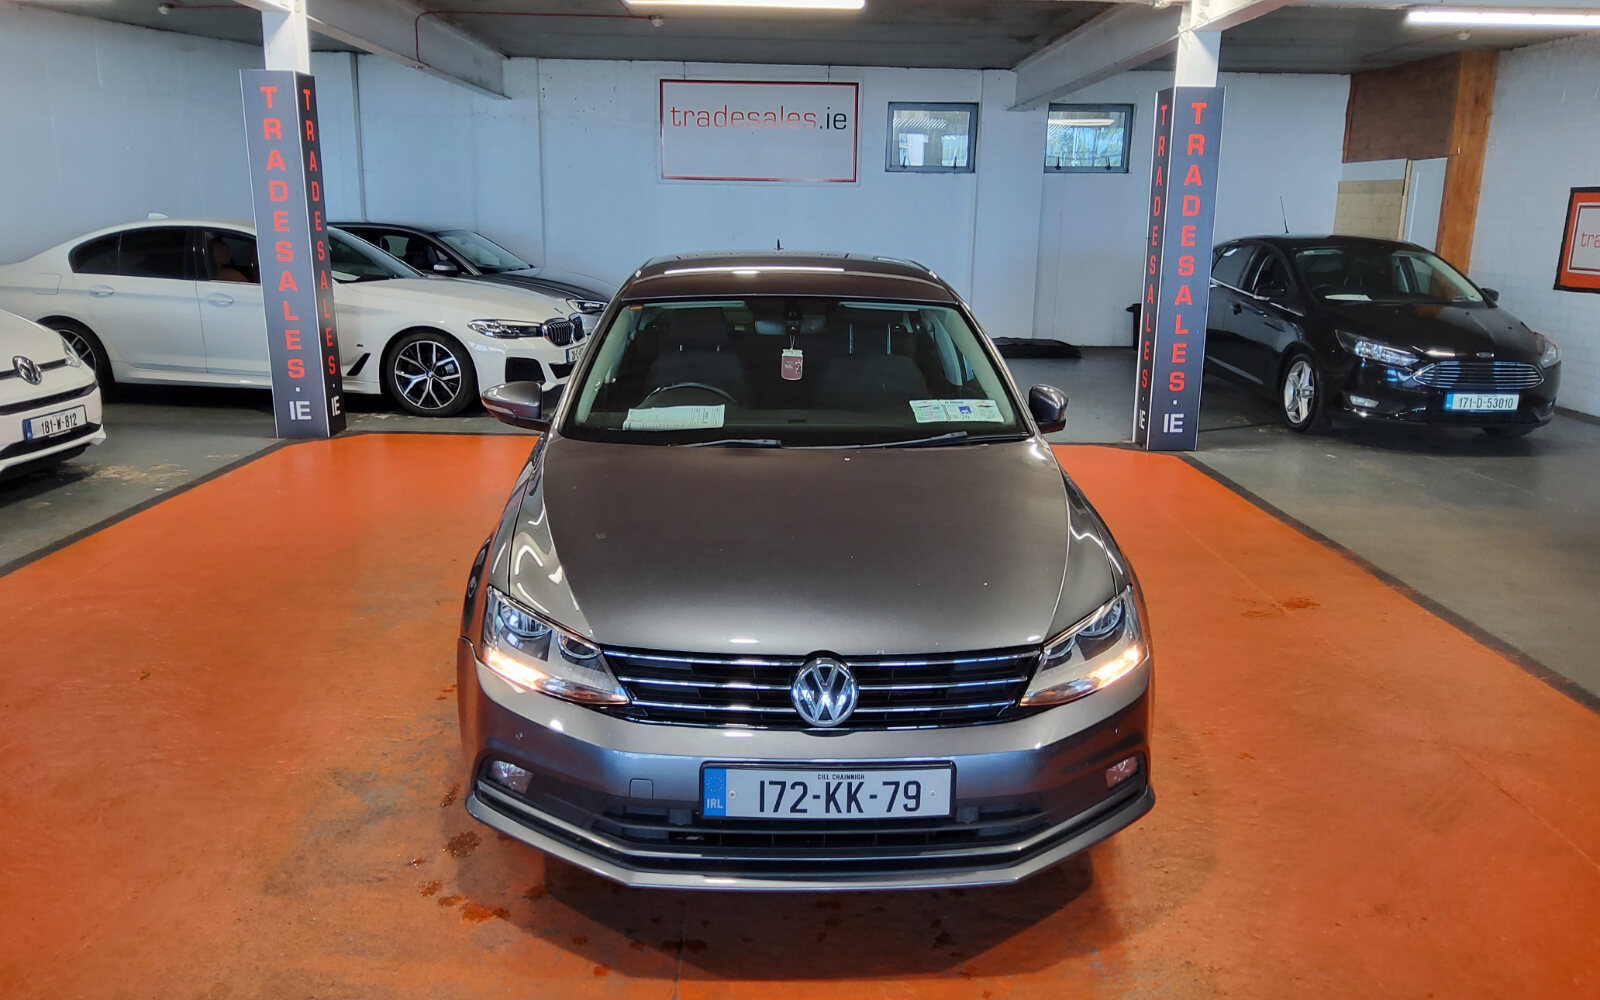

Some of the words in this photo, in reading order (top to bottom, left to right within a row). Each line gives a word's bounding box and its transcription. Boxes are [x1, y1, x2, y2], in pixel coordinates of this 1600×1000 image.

[669, 104, 848, 130] tradesales.ie
[1459, 397, 1514, 409] 171-D-53010
[40, 412, 78, 436] 181-W-812
[706, 798, 724, 809] IRL
[758, 780, 922, 815] 172-KK-79
